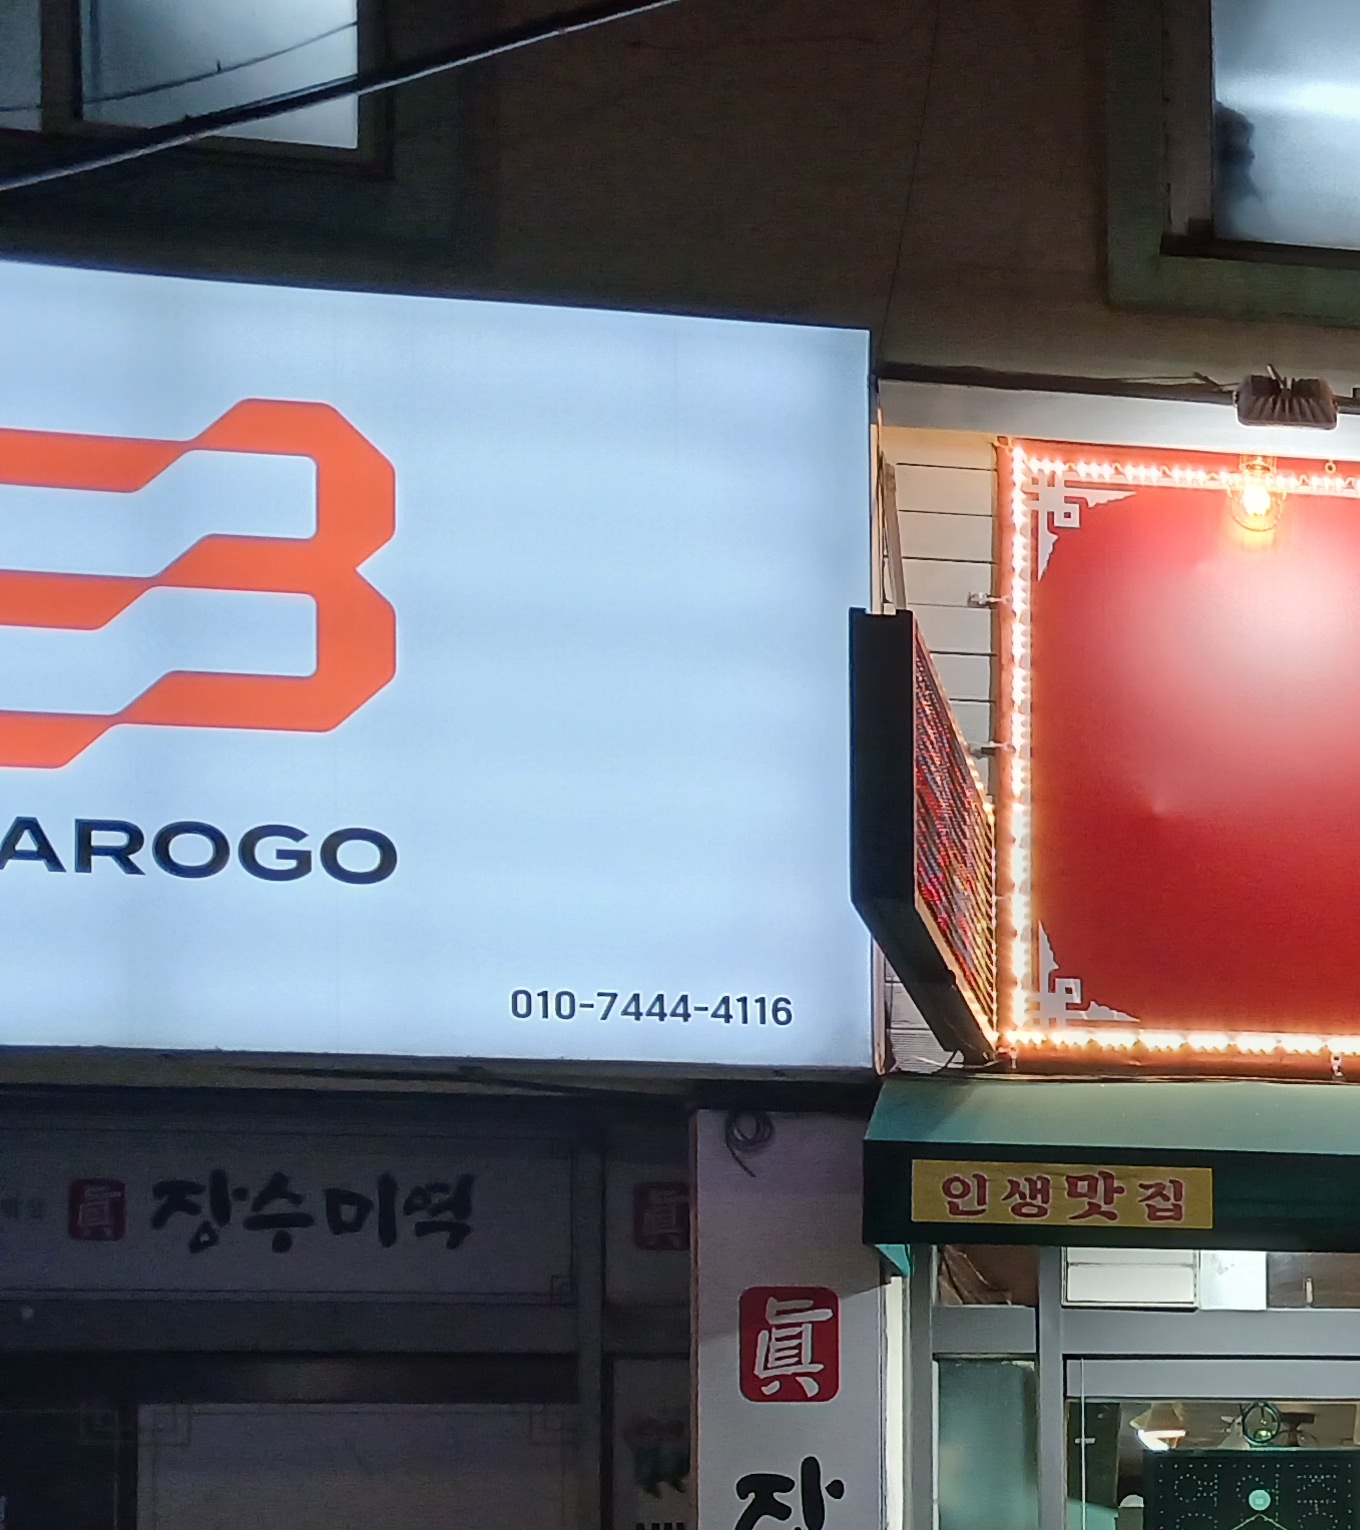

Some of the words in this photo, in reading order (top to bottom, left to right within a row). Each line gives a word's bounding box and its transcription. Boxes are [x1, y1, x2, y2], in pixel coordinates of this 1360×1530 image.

[0, 816, 397, 884] AROGO
[511, 989, 793, 1026] 010-7444-4116
[152, 1168, 475, 1253] 장수미역
[941, 1169, 1186, 1221] 인생맛집
